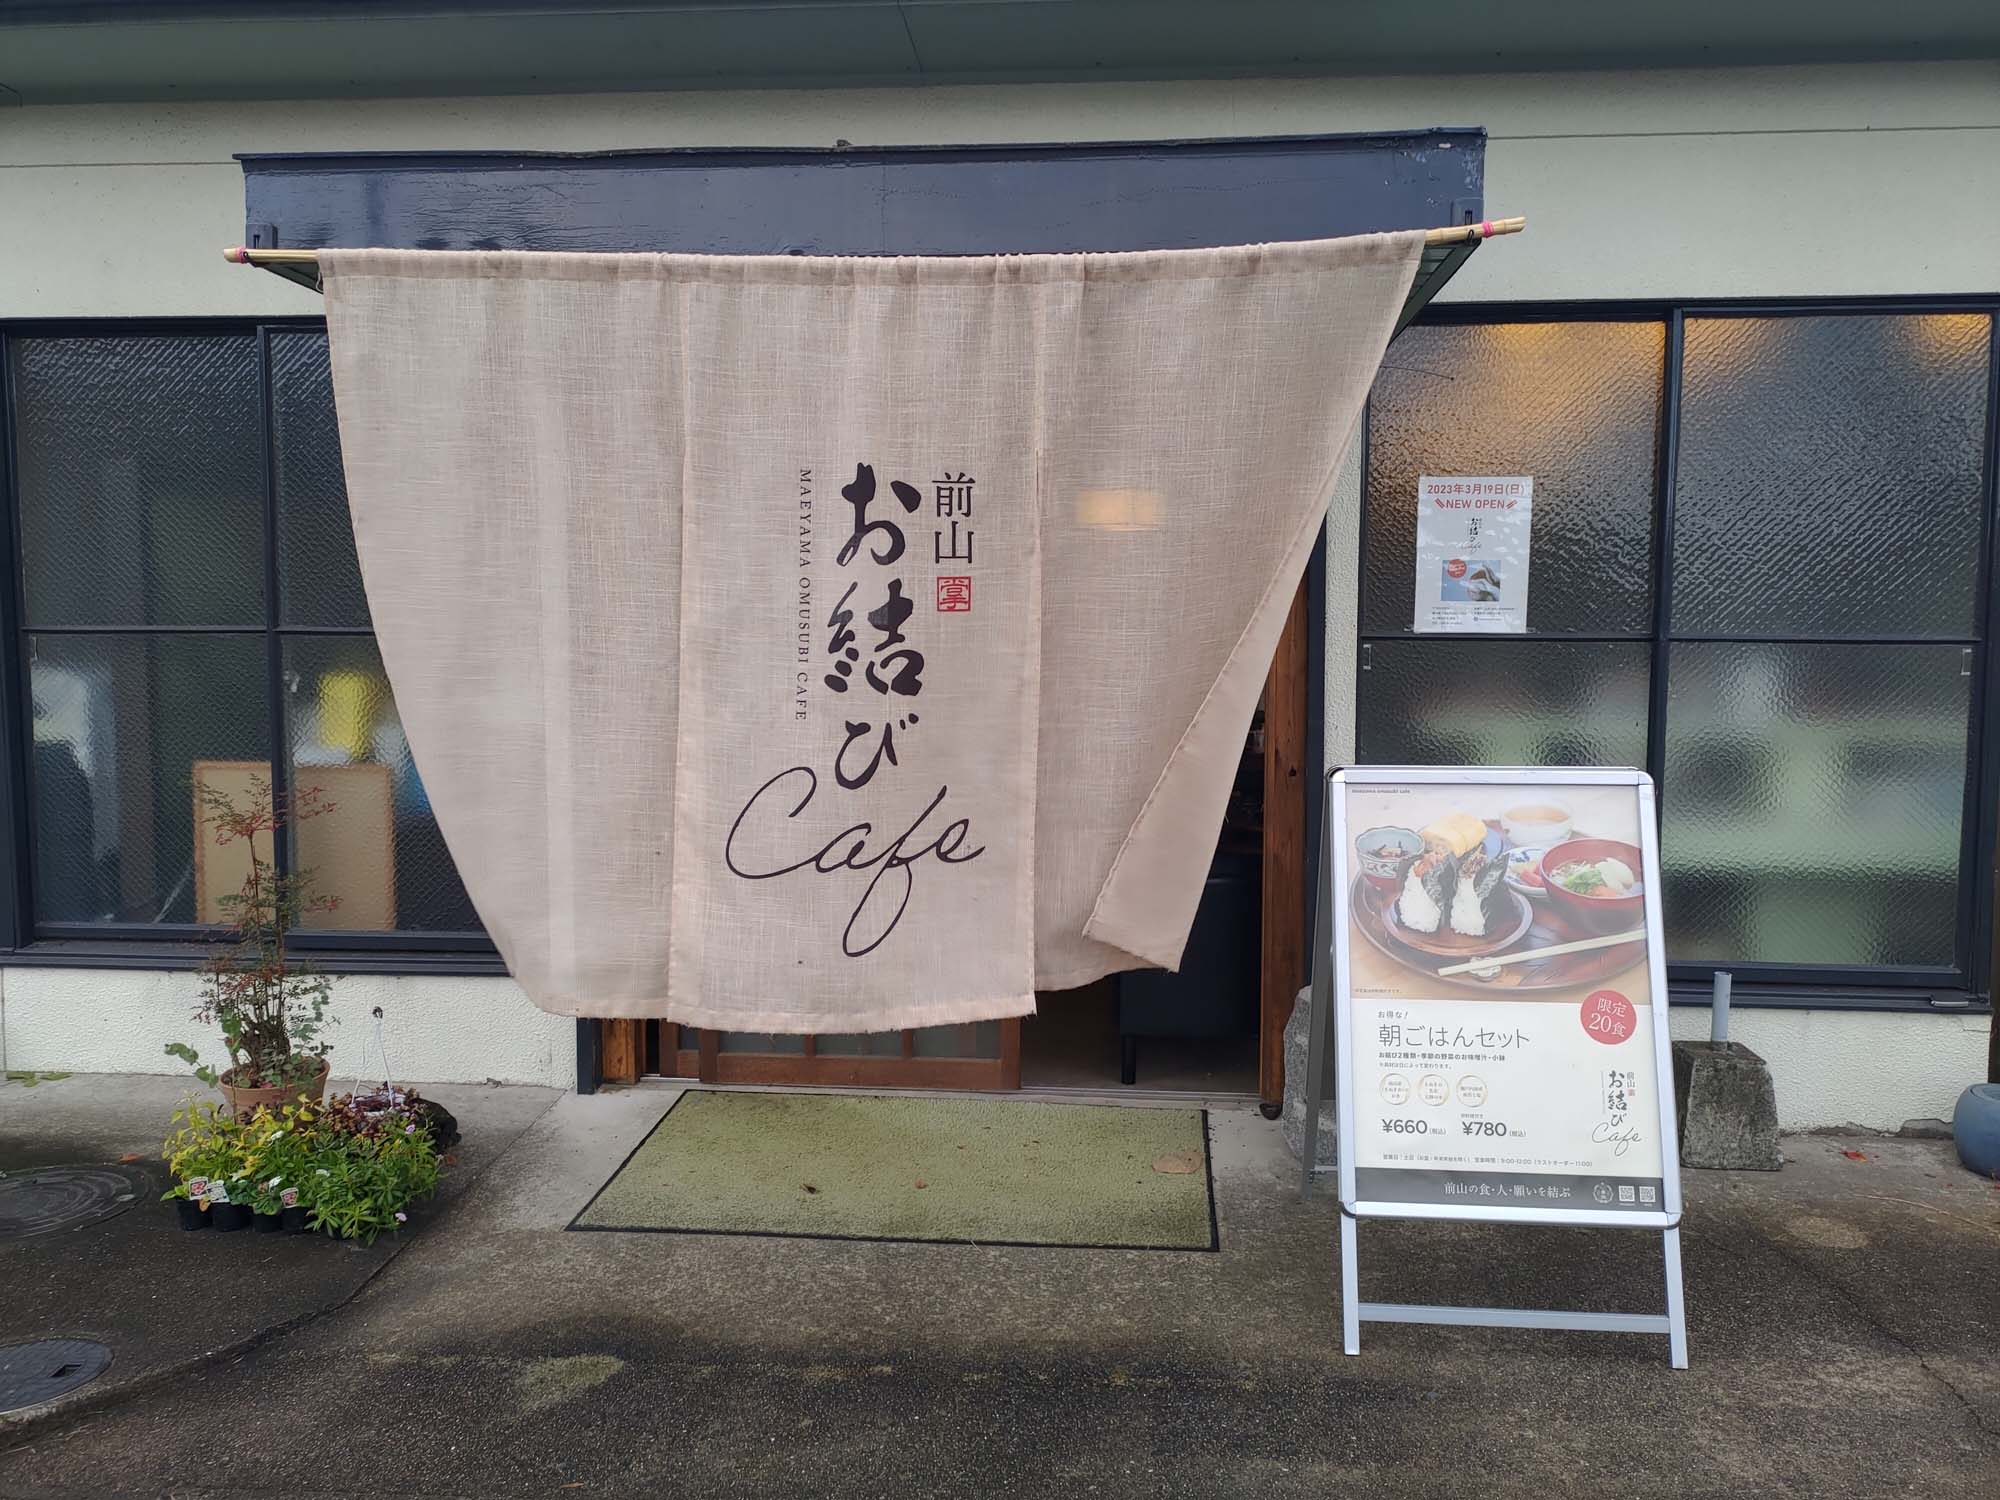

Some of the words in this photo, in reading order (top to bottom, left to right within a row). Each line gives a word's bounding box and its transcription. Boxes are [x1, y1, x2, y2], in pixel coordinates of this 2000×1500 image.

[1427, 483, 1525, 495] 2023年3月19日(日)
[1446, 500, 1471, 509] NEW
[1475, 500, 1505, 509] OPEN
[800, 469, 812, 568] MAEYAMA
[932, 472, 976, 564] 前山
[799, 577, 811, 664] OMUSUBI
[824, 462, 925, 789] お結び
[795, 672, 808, 721] CAFE
[726, 766, 986, 957] Cafe
[1589, 1013, 1627, 1038] 20食
[1597, 998, 1627, 1018] 限定
[1379, 1024, 1530, 1049] 朝ごはんセット
[1608, 1070, 1627, 1127] お結び
[1381, 1119, 1428, 1135] ¥660
[1462, 1121, 1507, 1137] ¥780
[1592, 1122, 1643, 1157] Cafe
